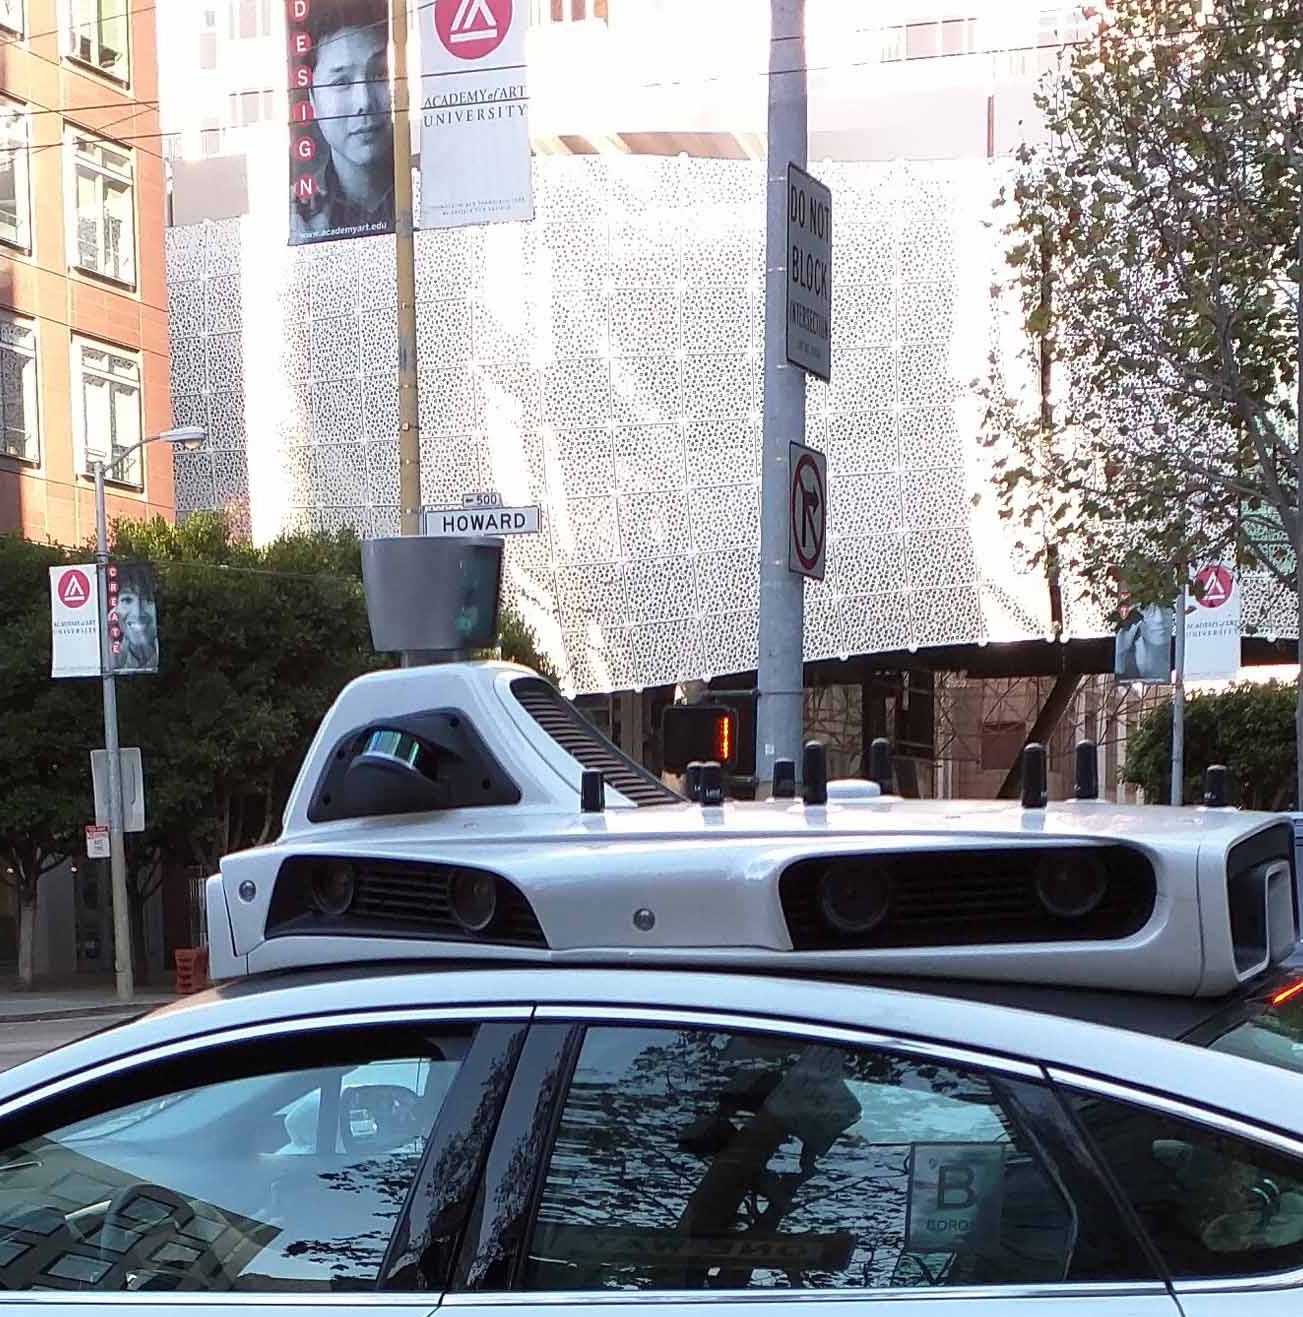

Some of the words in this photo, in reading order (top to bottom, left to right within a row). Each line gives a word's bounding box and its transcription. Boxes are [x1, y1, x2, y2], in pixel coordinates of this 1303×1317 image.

[424, 89, 488, 108] ACADEMY
[500, 85, 526, 98] ART
[423, 104, 527, 127] UNIVERSITY
[790, 184, 805, 228] DO
[810, 197, 830, 244] NOT
[792, 245, 828, 300] BLOCK
[477, 494, 497, 505] 500
[443, 512, 526, 532] HOWARD
